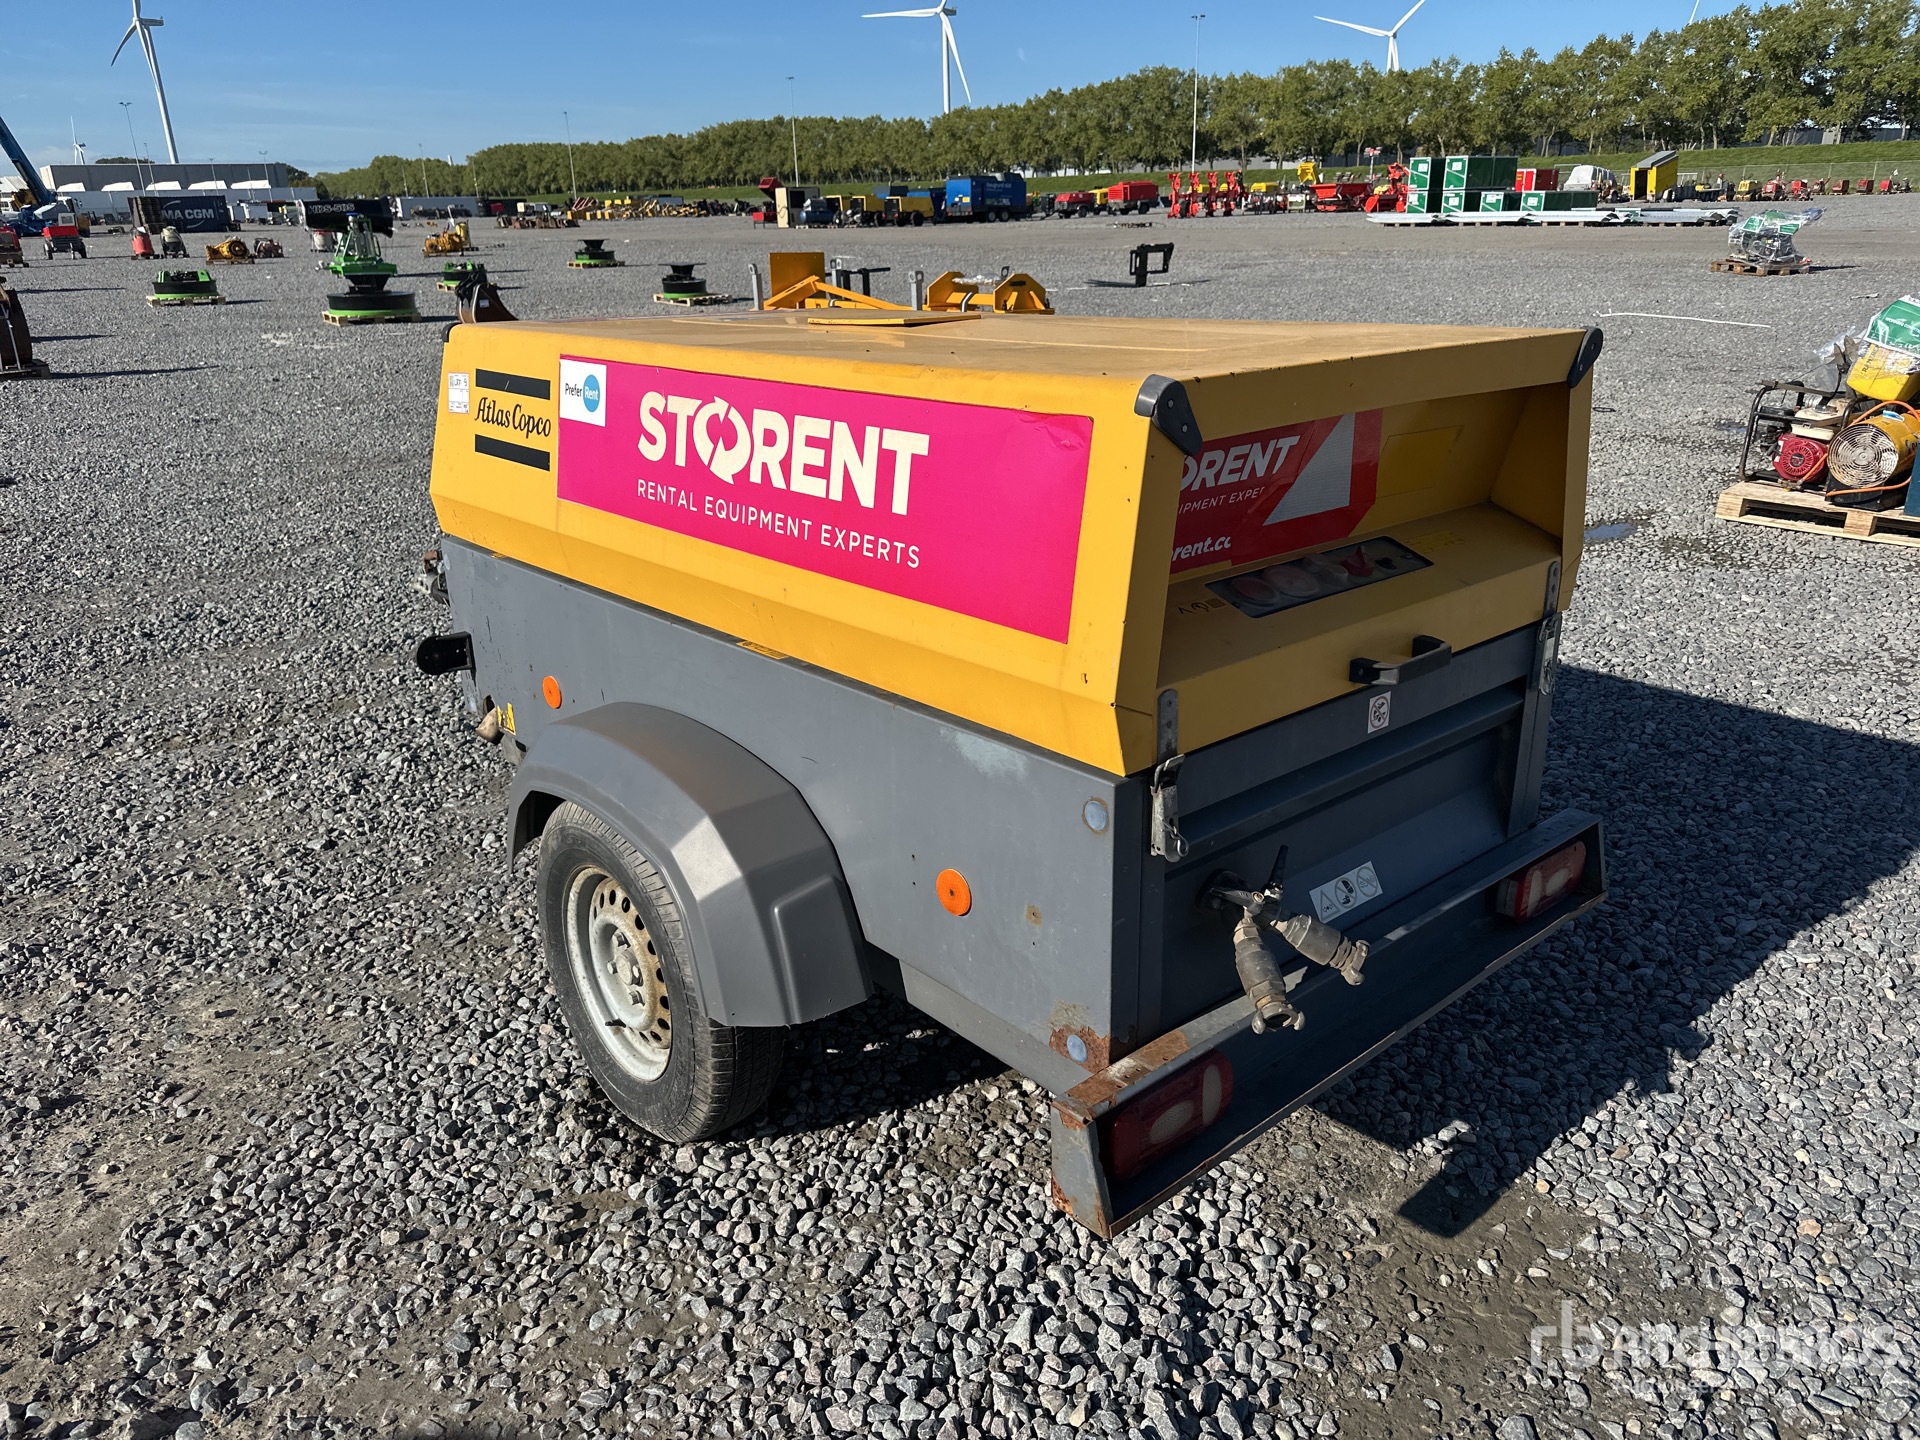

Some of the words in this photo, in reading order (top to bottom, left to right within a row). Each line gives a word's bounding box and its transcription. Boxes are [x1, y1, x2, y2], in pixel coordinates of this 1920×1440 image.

[161, 209, 184, 220] MA
[184, 208, 215, 220] CGM
[565, 382, 582, 398] Prefer
[584, 385, 599, 401] Rent
[475, 396, 511, 428] Atlas
[512, 403, 551, 439] Copco
[637, 391, 930, 516] STORENT
[1178, 494, 1227, 515] IPMENT
[637, 479, 698, 512] RENTAL
[704, 496, 812, 541] EQUIPMENT
[820, 525, 920, 569] EXPERTS
[1171, 536, 1232, 562] rent.c
